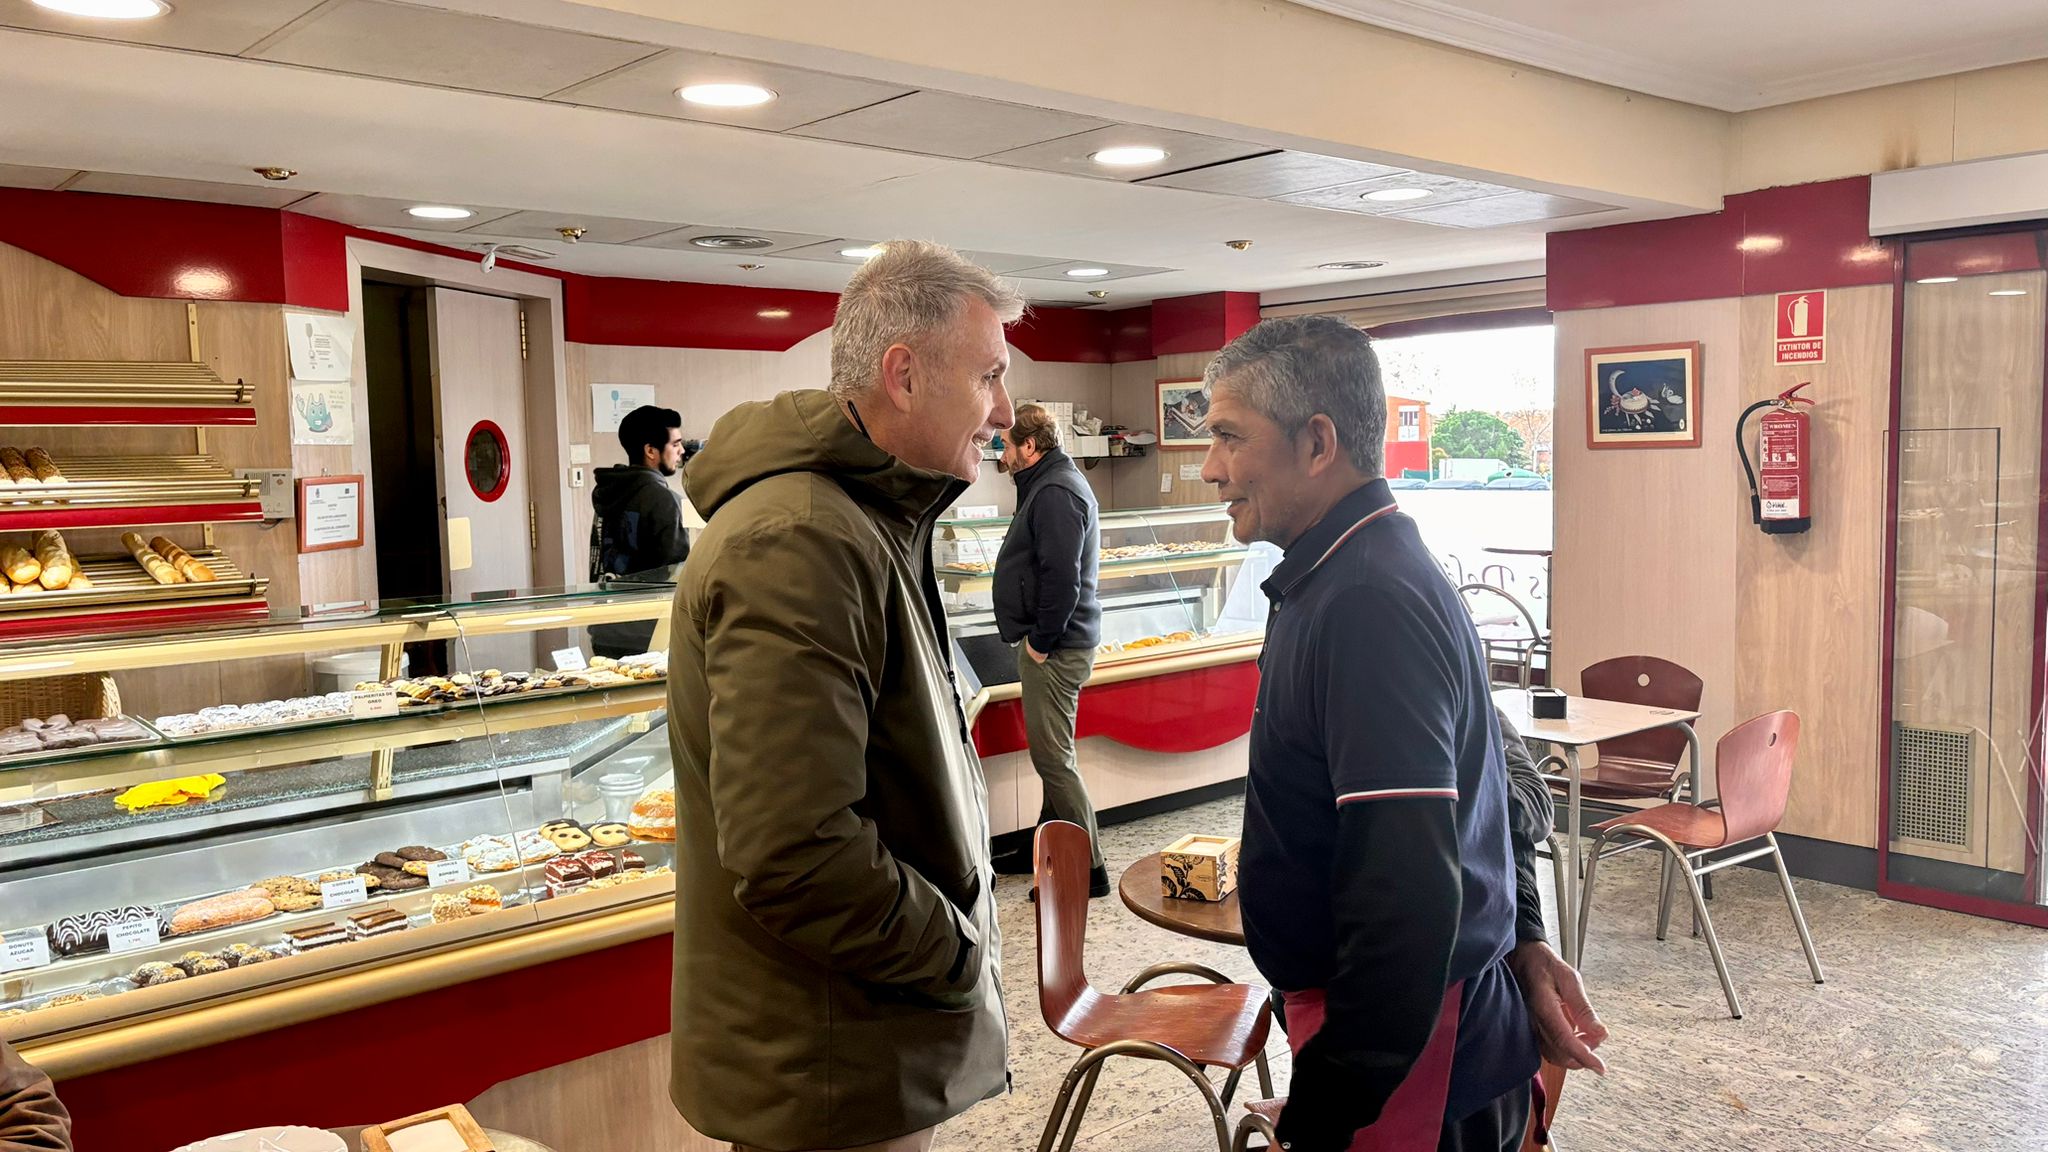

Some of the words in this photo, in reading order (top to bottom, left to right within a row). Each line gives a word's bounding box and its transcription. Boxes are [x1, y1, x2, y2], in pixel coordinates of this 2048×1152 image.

[1779, 343, 1811, 352] EXTINTOR
[1812, 341, 1822, 350] DE
[1781, 351, 1818, 360] INCENDIOS
[354, 692, 385, 700] PALMERITAS
[329, 888, 360, 898] CHOCOLATE
[122, 922, 143, 930] PEPITO
[115, 927, 150, 938] CHOCOLATE
[8, 941, 34, 950] DONUTS
[9, 947, 35, 956] AZUCAR
